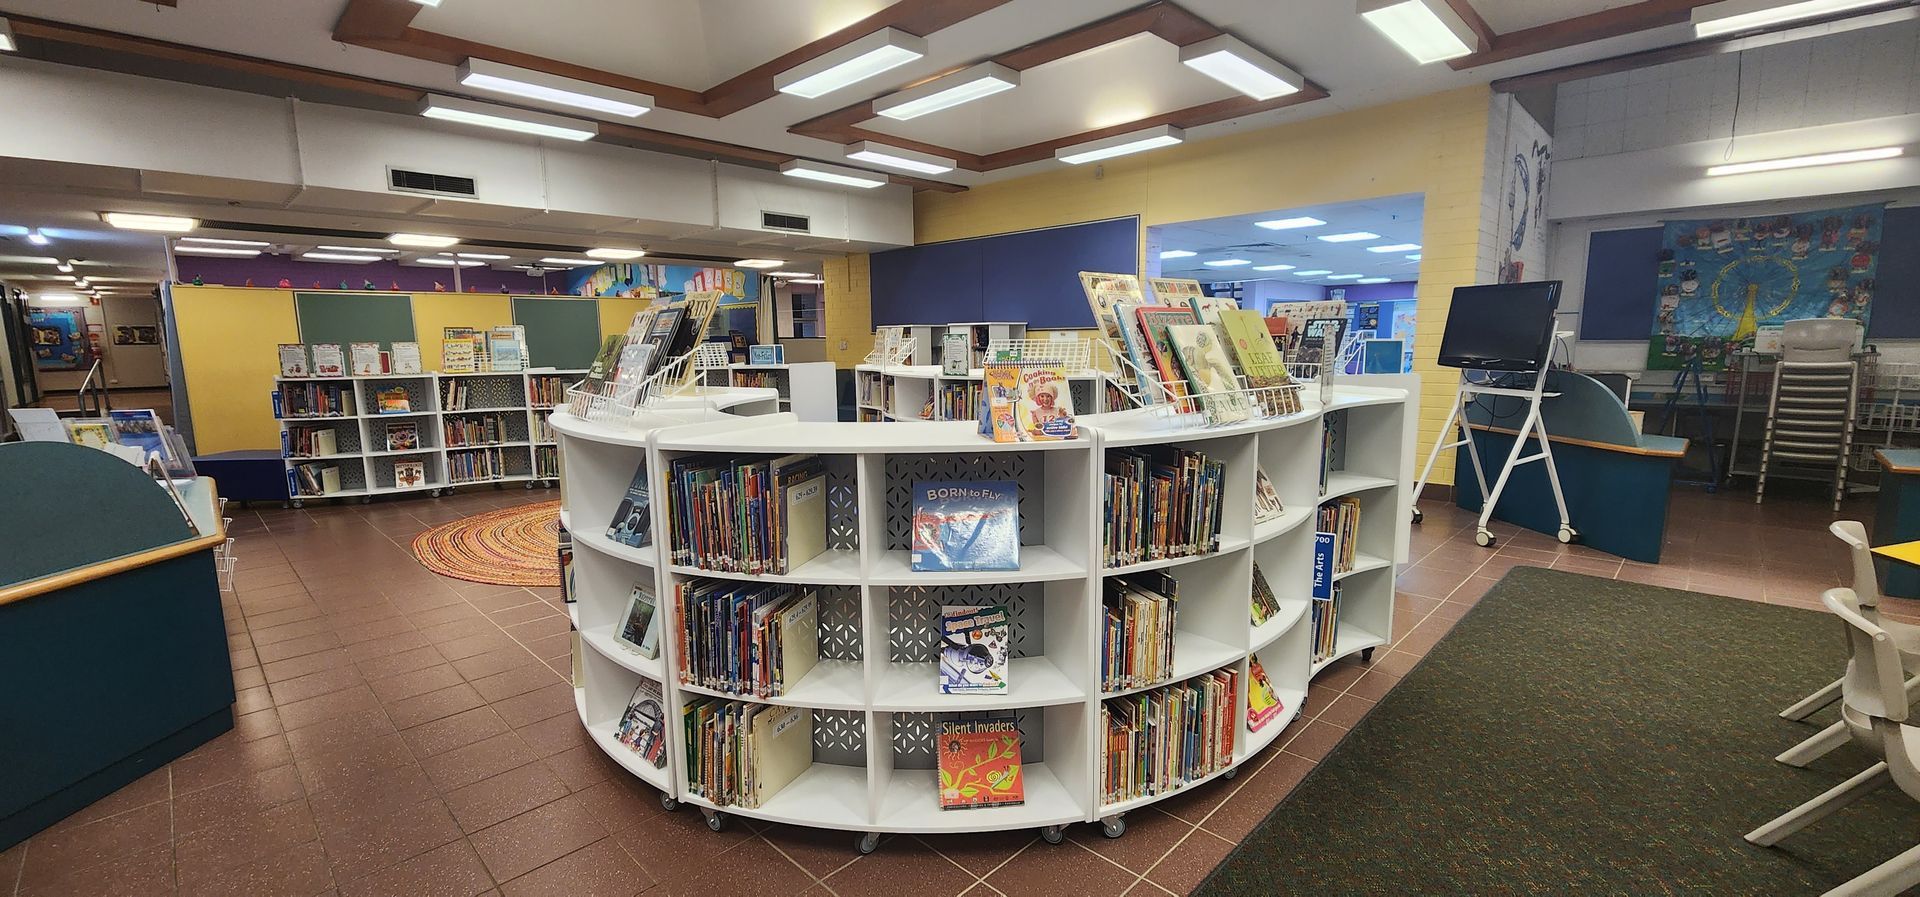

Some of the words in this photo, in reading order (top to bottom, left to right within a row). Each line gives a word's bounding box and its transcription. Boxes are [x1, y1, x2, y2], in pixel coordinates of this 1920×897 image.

[1248, 351, 1274, 364] LEAF
[1249, 365, 1286, 378] LITTER
[1042, 415, 1055, 423] 12
[927, 487, 967, 501] BORN
[970, 489, 980, 498] to
[982, 489, 1001, 500] FLY
[1315, 536, 1330, 544] 700
[1315, 552, 1325, 571] Arts
[1314, 572, 1324, 587] The
[946, 619, 974, 632] Space
[974, 611, 1005, 625] Travel
[943, 721, 971, 735] Silent
[975, 719, 1015, 733] Invaders
